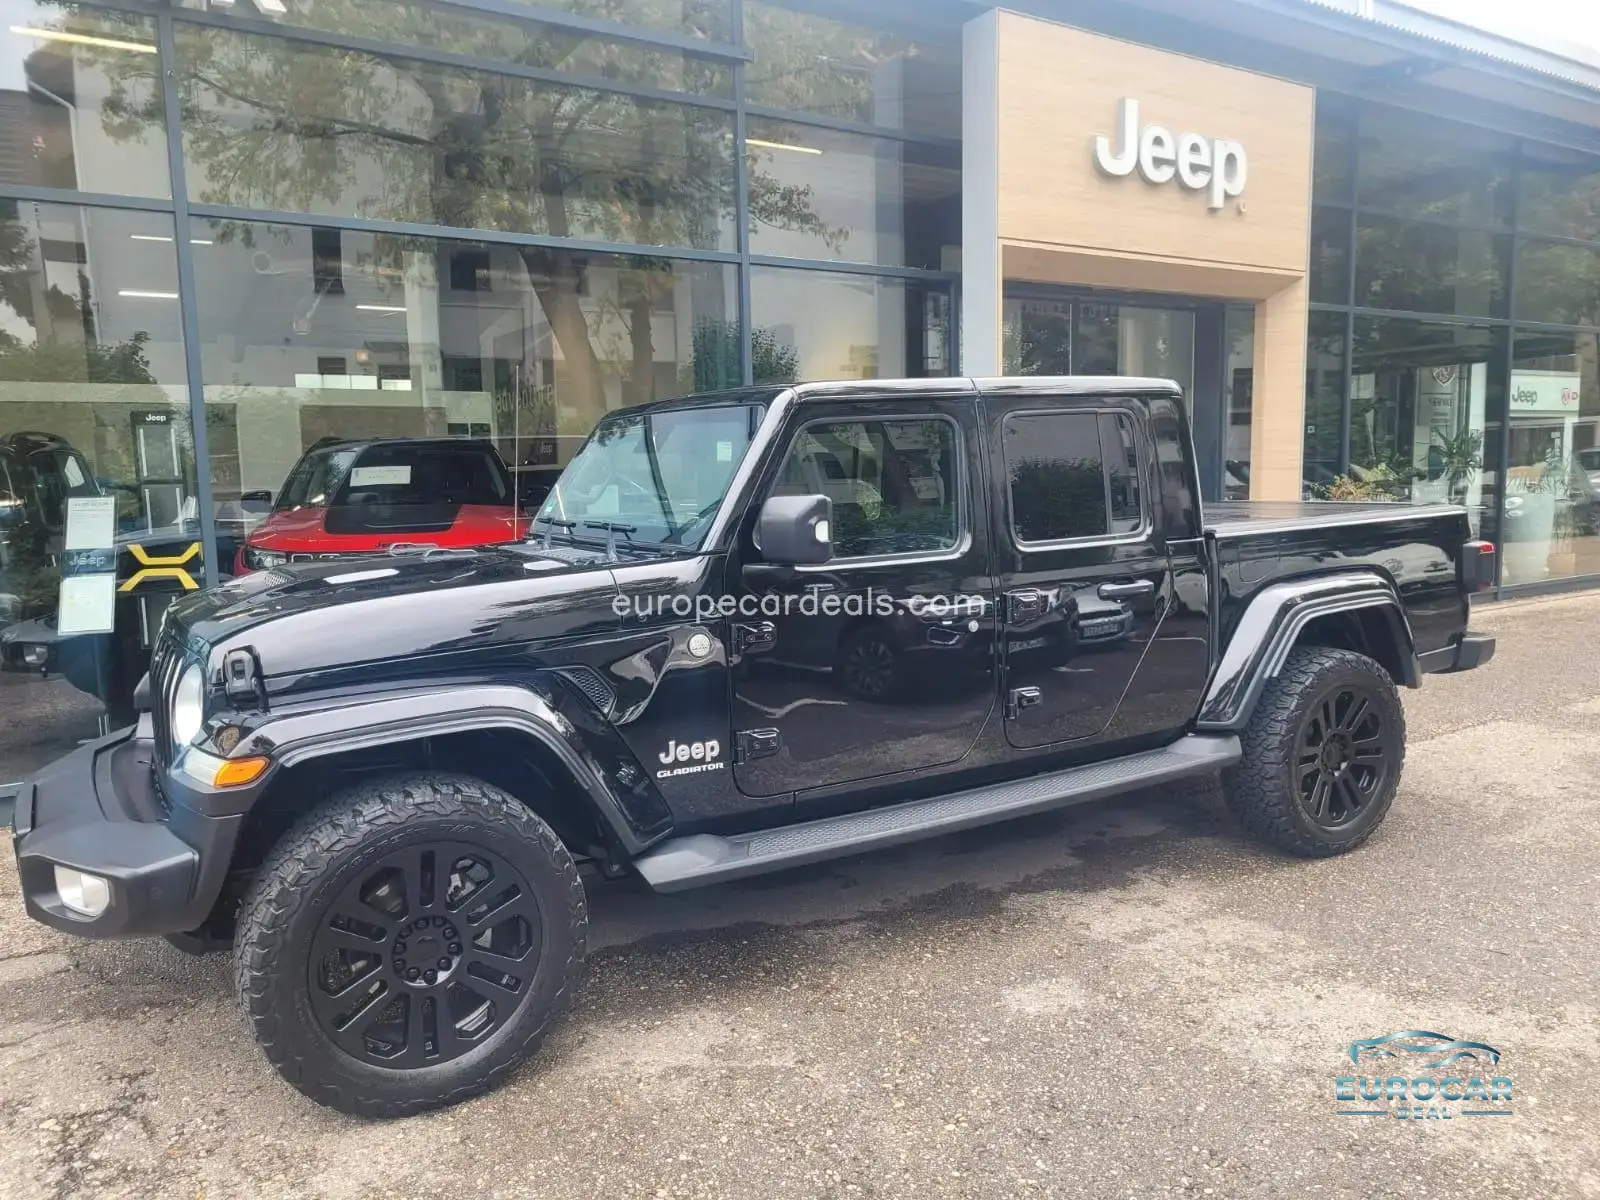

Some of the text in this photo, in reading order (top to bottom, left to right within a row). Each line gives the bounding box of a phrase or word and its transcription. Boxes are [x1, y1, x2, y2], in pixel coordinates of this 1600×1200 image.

[1094, 97, 1248, 210] Jeep
[1511, 384, 1538, 406] Jeep
[145, 413, 167, 422] Jeep
[69, 554, 106, 567] Jeep
[659, 739, 720, 764] Jeep
[656, 762, 725, 779] GLADIATOR
